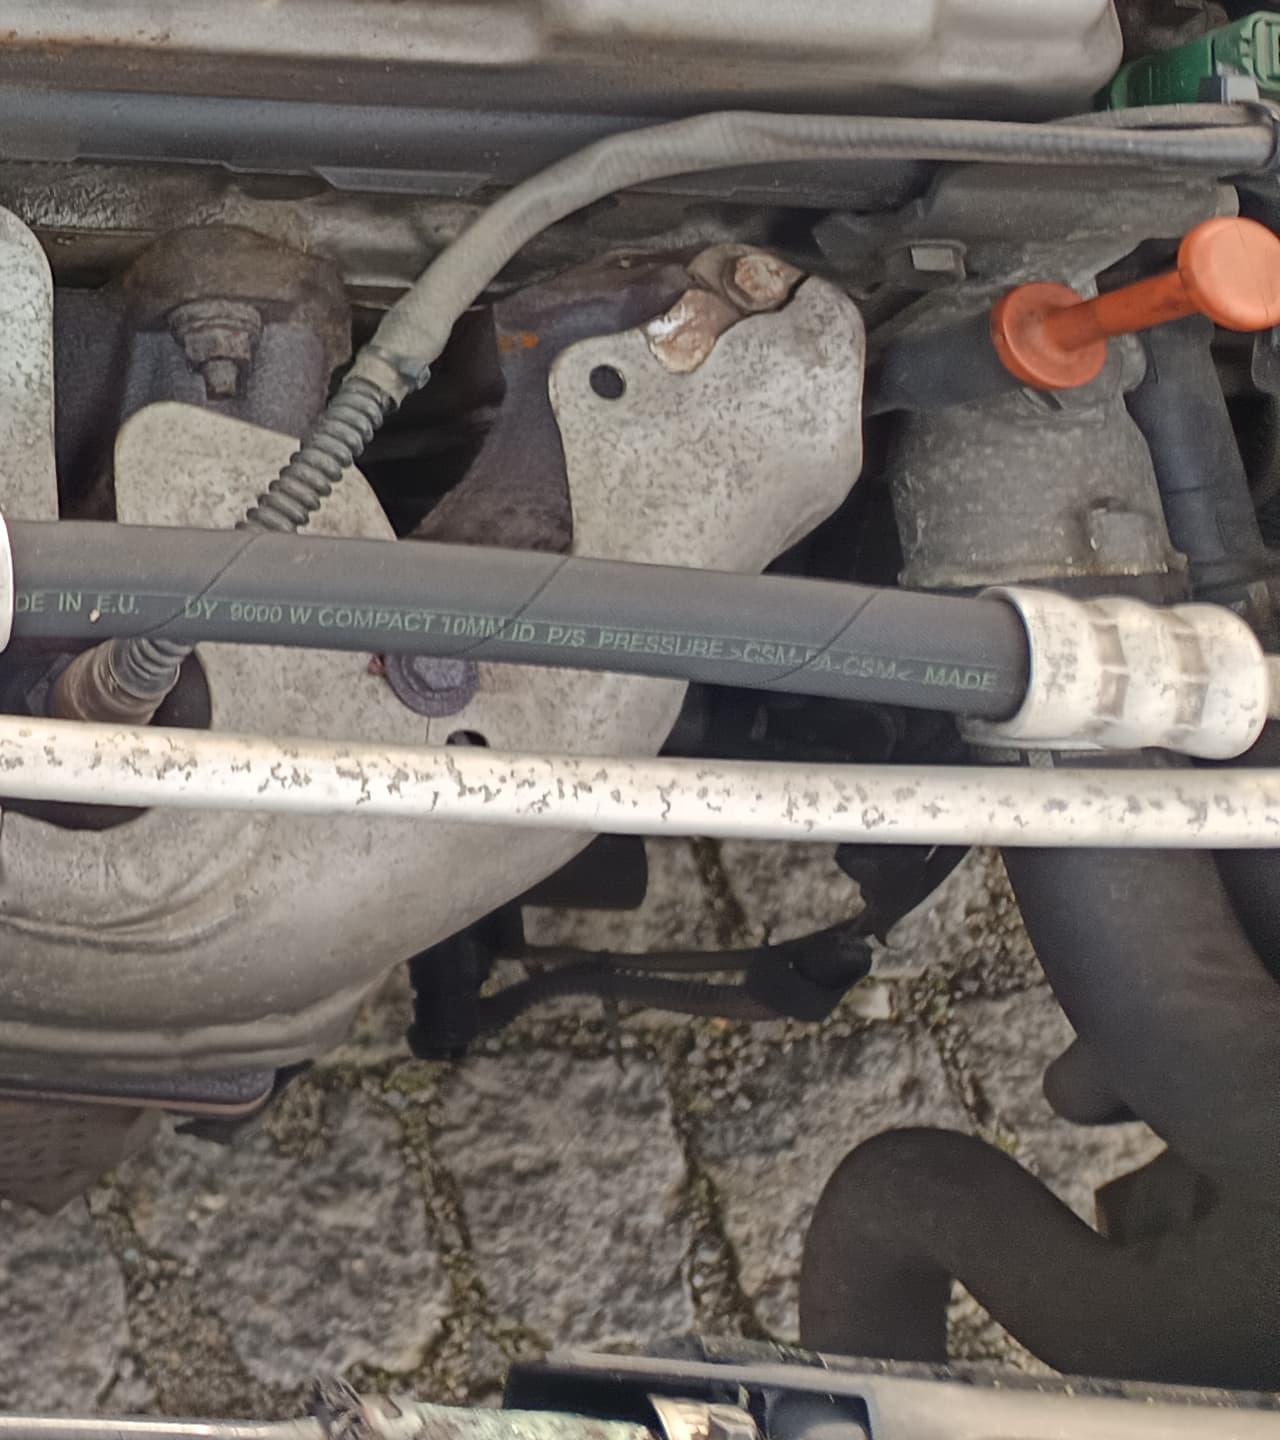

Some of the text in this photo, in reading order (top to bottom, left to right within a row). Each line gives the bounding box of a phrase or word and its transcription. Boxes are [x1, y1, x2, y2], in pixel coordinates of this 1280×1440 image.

[15, 594, 45, 612] DE
[58, 592, 82, 612] IN
[95, 592, 140, 614] E.U.
[183, 599, 218, 621] DY
[289, 607, 312, 625] W
[317, 606, 436, 634] COMPACT
[441, 614, 506, 639] 10MM
[510, 618, 536, 642] ID
[546, 625, 586, 648] P/S
[597, 629, 726, 659] PRESSURE
[923, 665, 1000, 691] MADE
